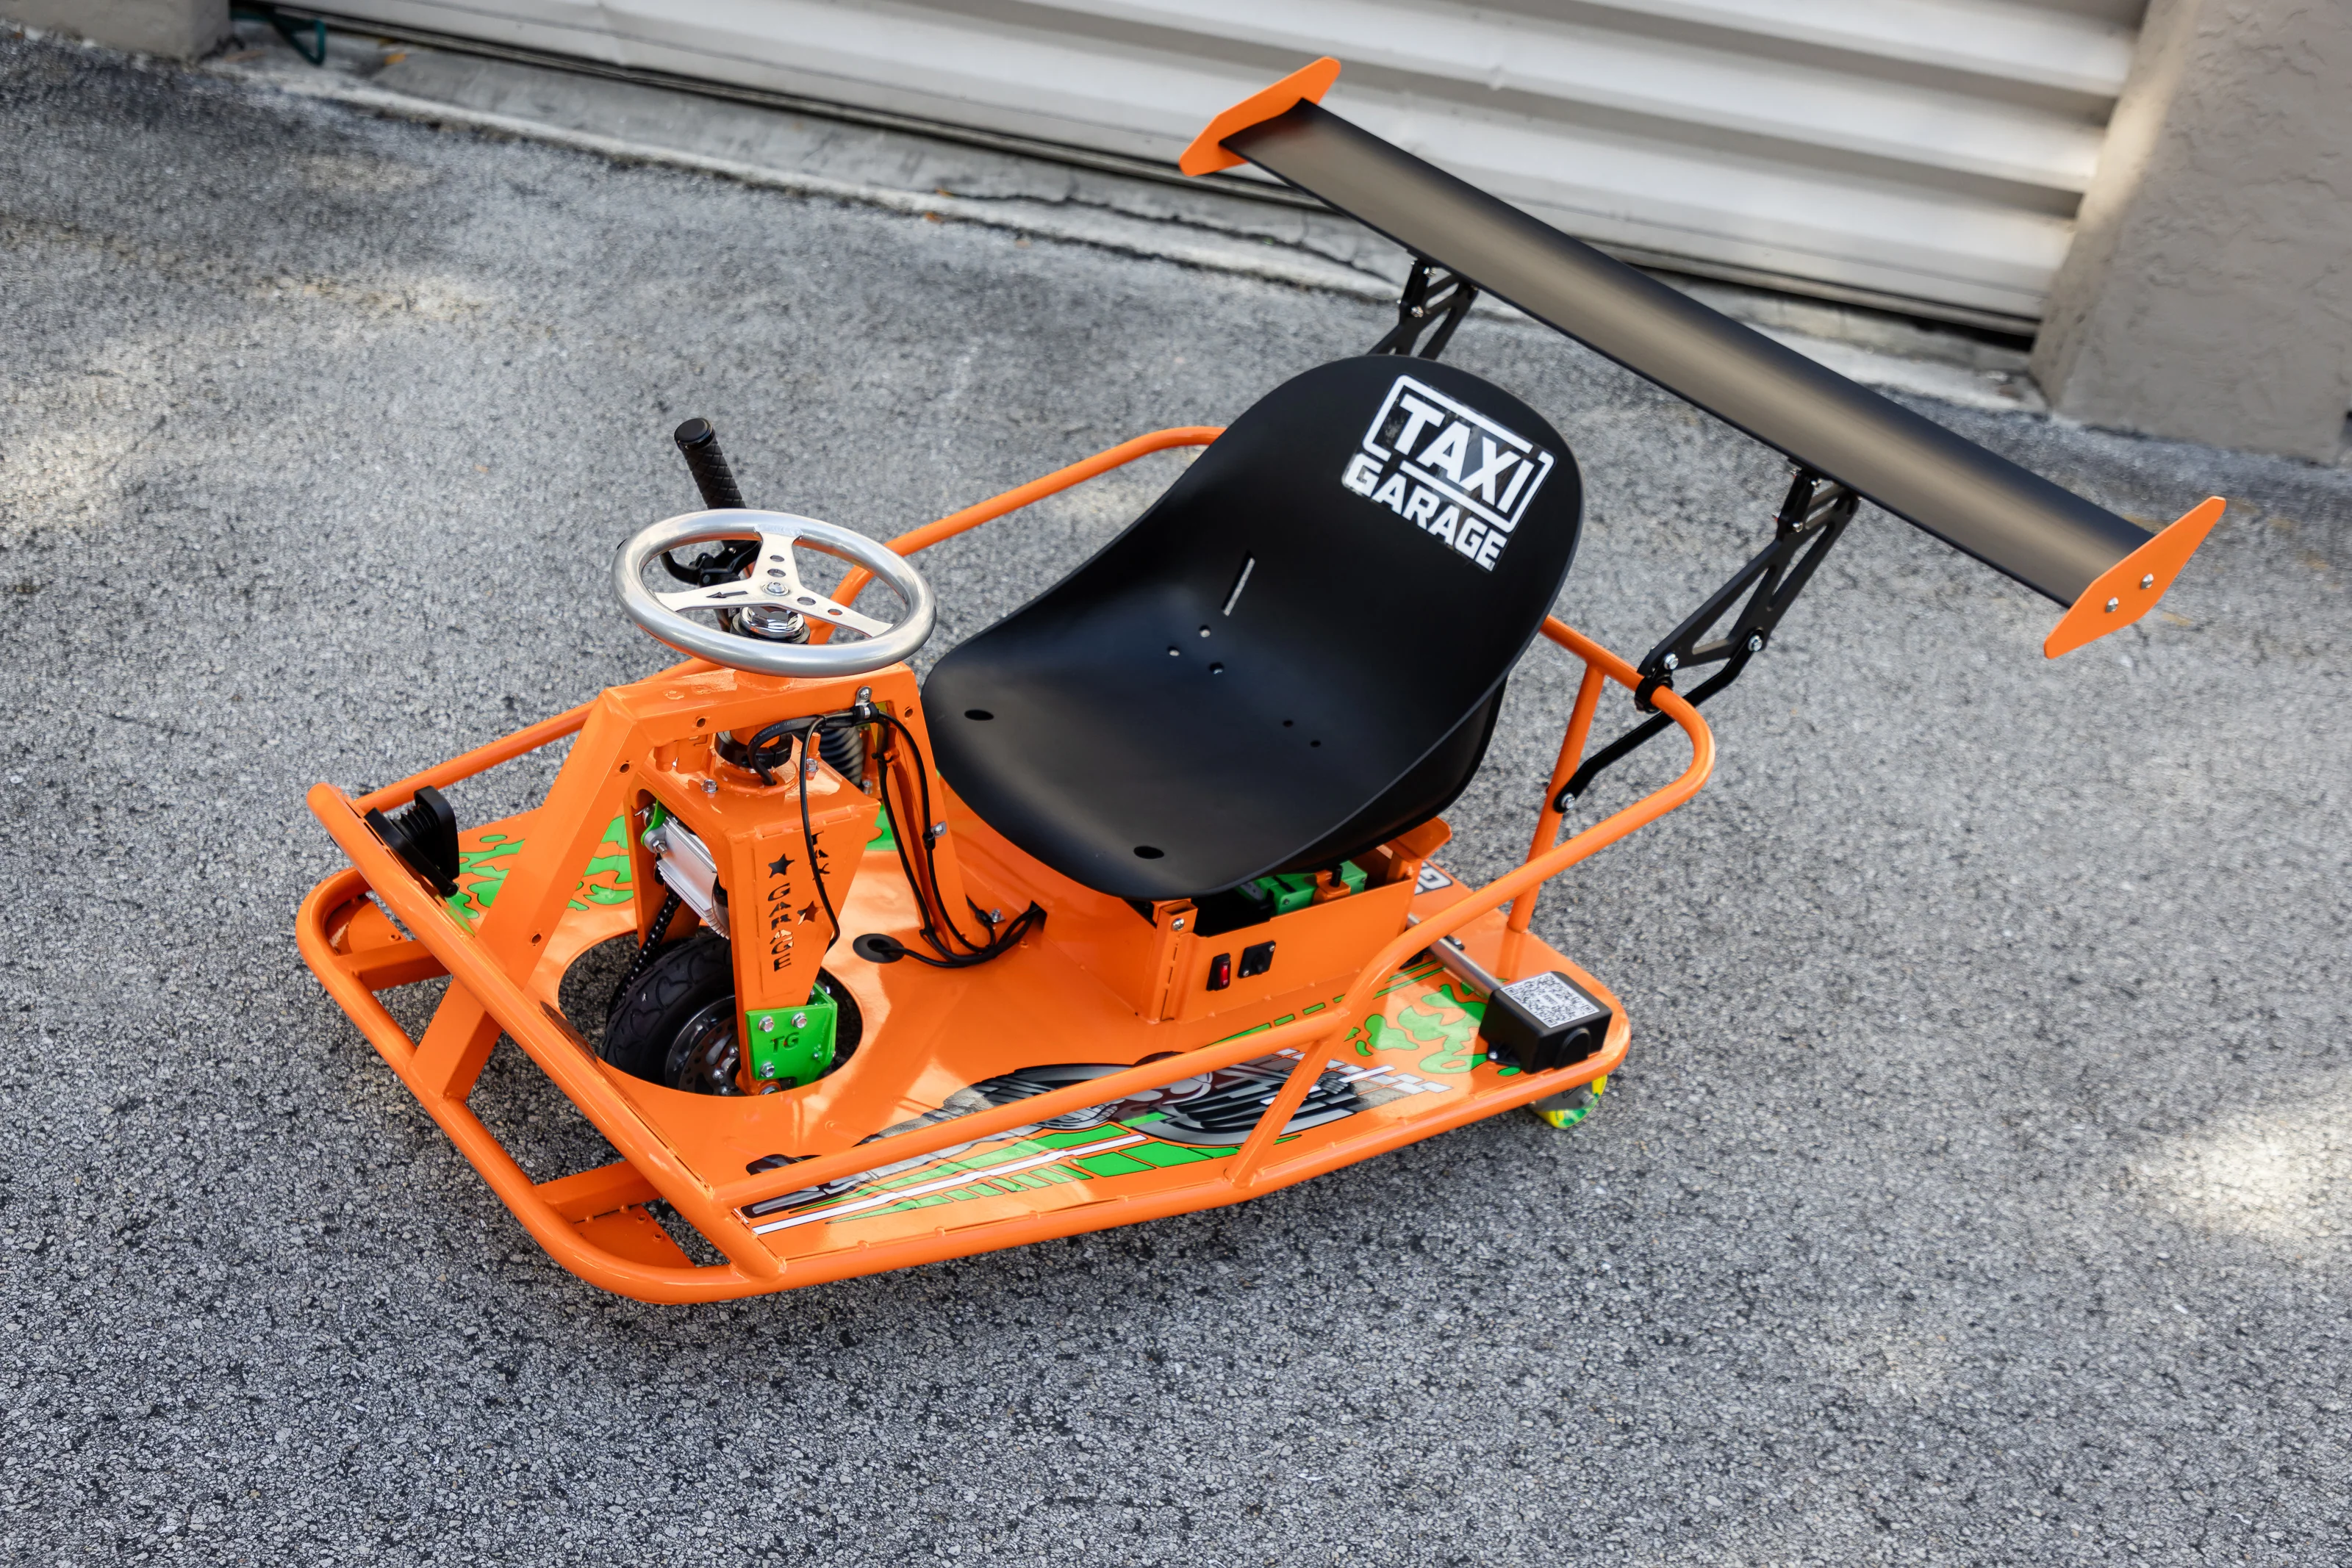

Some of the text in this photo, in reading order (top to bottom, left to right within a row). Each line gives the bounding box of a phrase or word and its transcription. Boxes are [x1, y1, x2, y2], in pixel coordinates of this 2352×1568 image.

[1394, 394, 1535, 513] TAXI
[1344, 453, 1507, 571] GARAGE
[767, 882, 793, 972] GARAGE
[770, 1032, 800, 1054] TG
